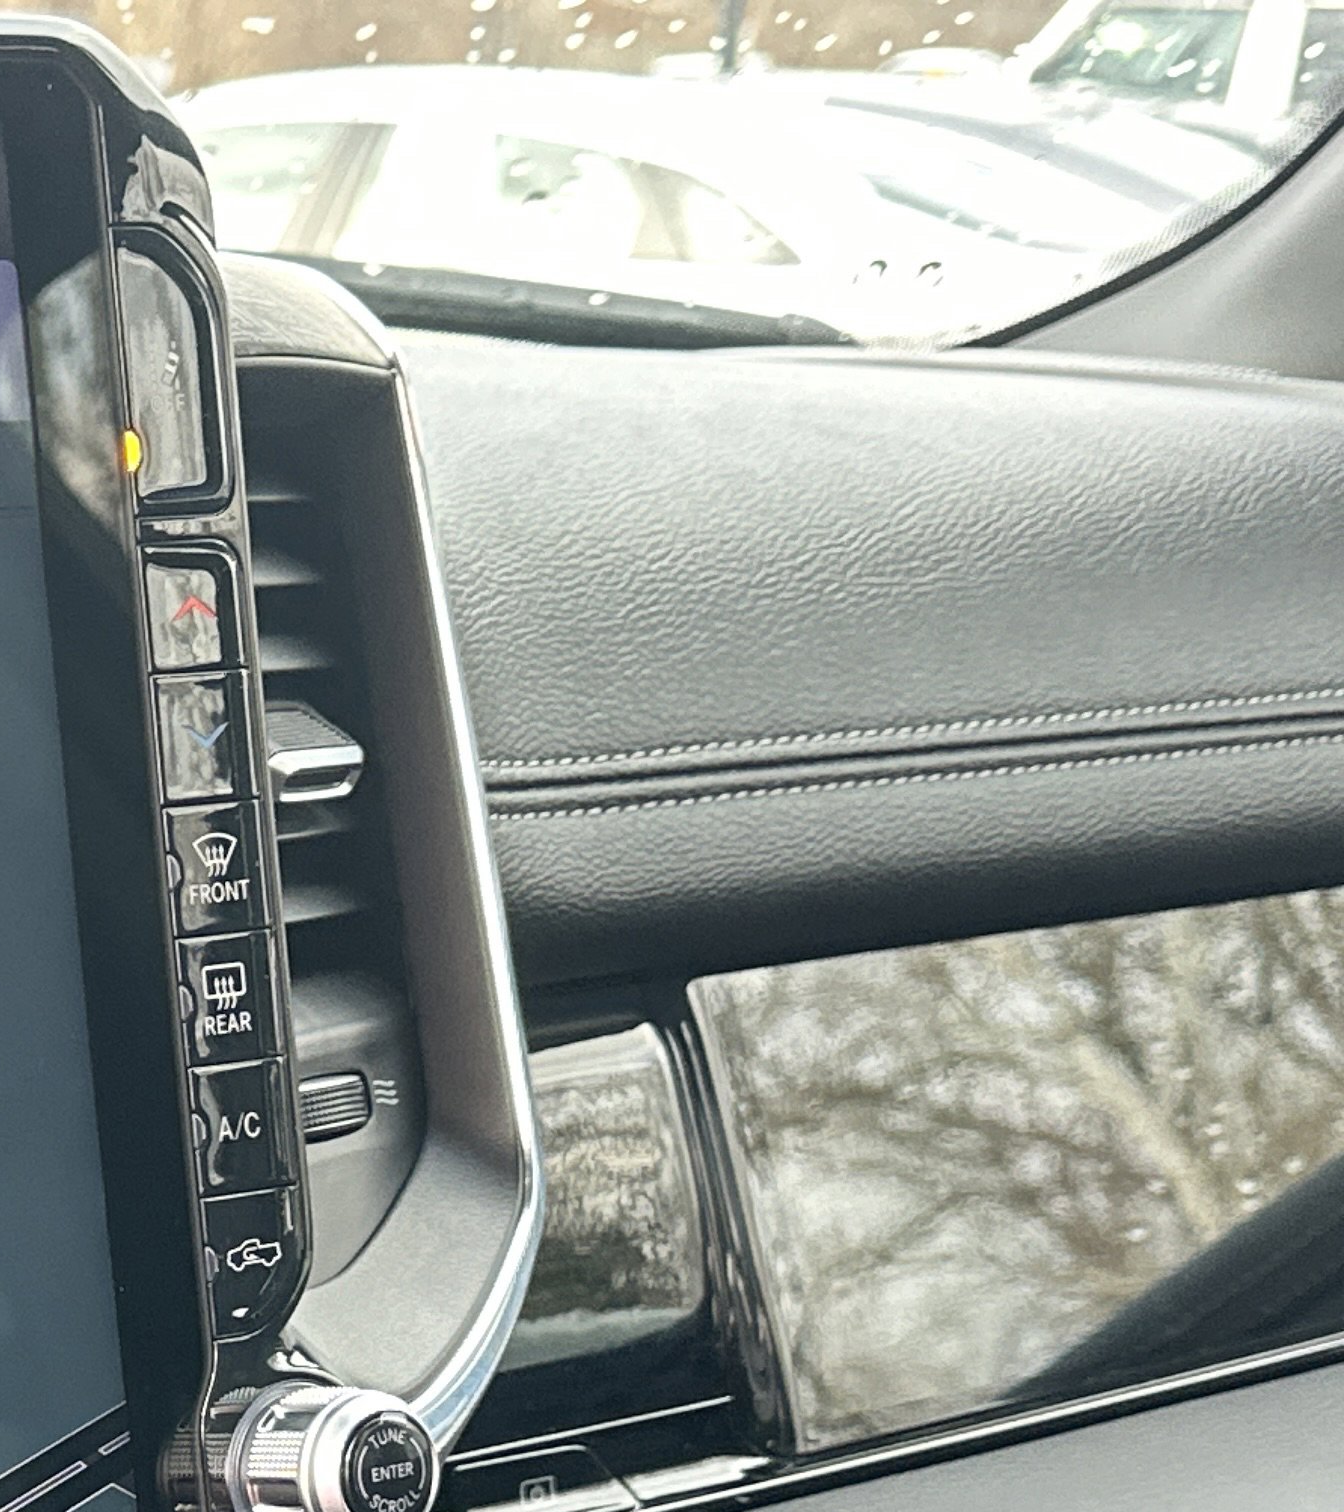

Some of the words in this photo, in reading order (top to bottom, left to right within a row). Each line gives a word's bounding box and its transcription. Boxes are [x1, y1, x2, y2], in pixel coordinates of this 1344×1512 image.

[189, 878, 251, 904] FRONT
[204, 1012, 253, 1035] REAR
[218, 1110, 261, 1141] A/C
[368, 1428, 407, 1449] TUNE
[371, 1461, 414, 1483] ENTER
